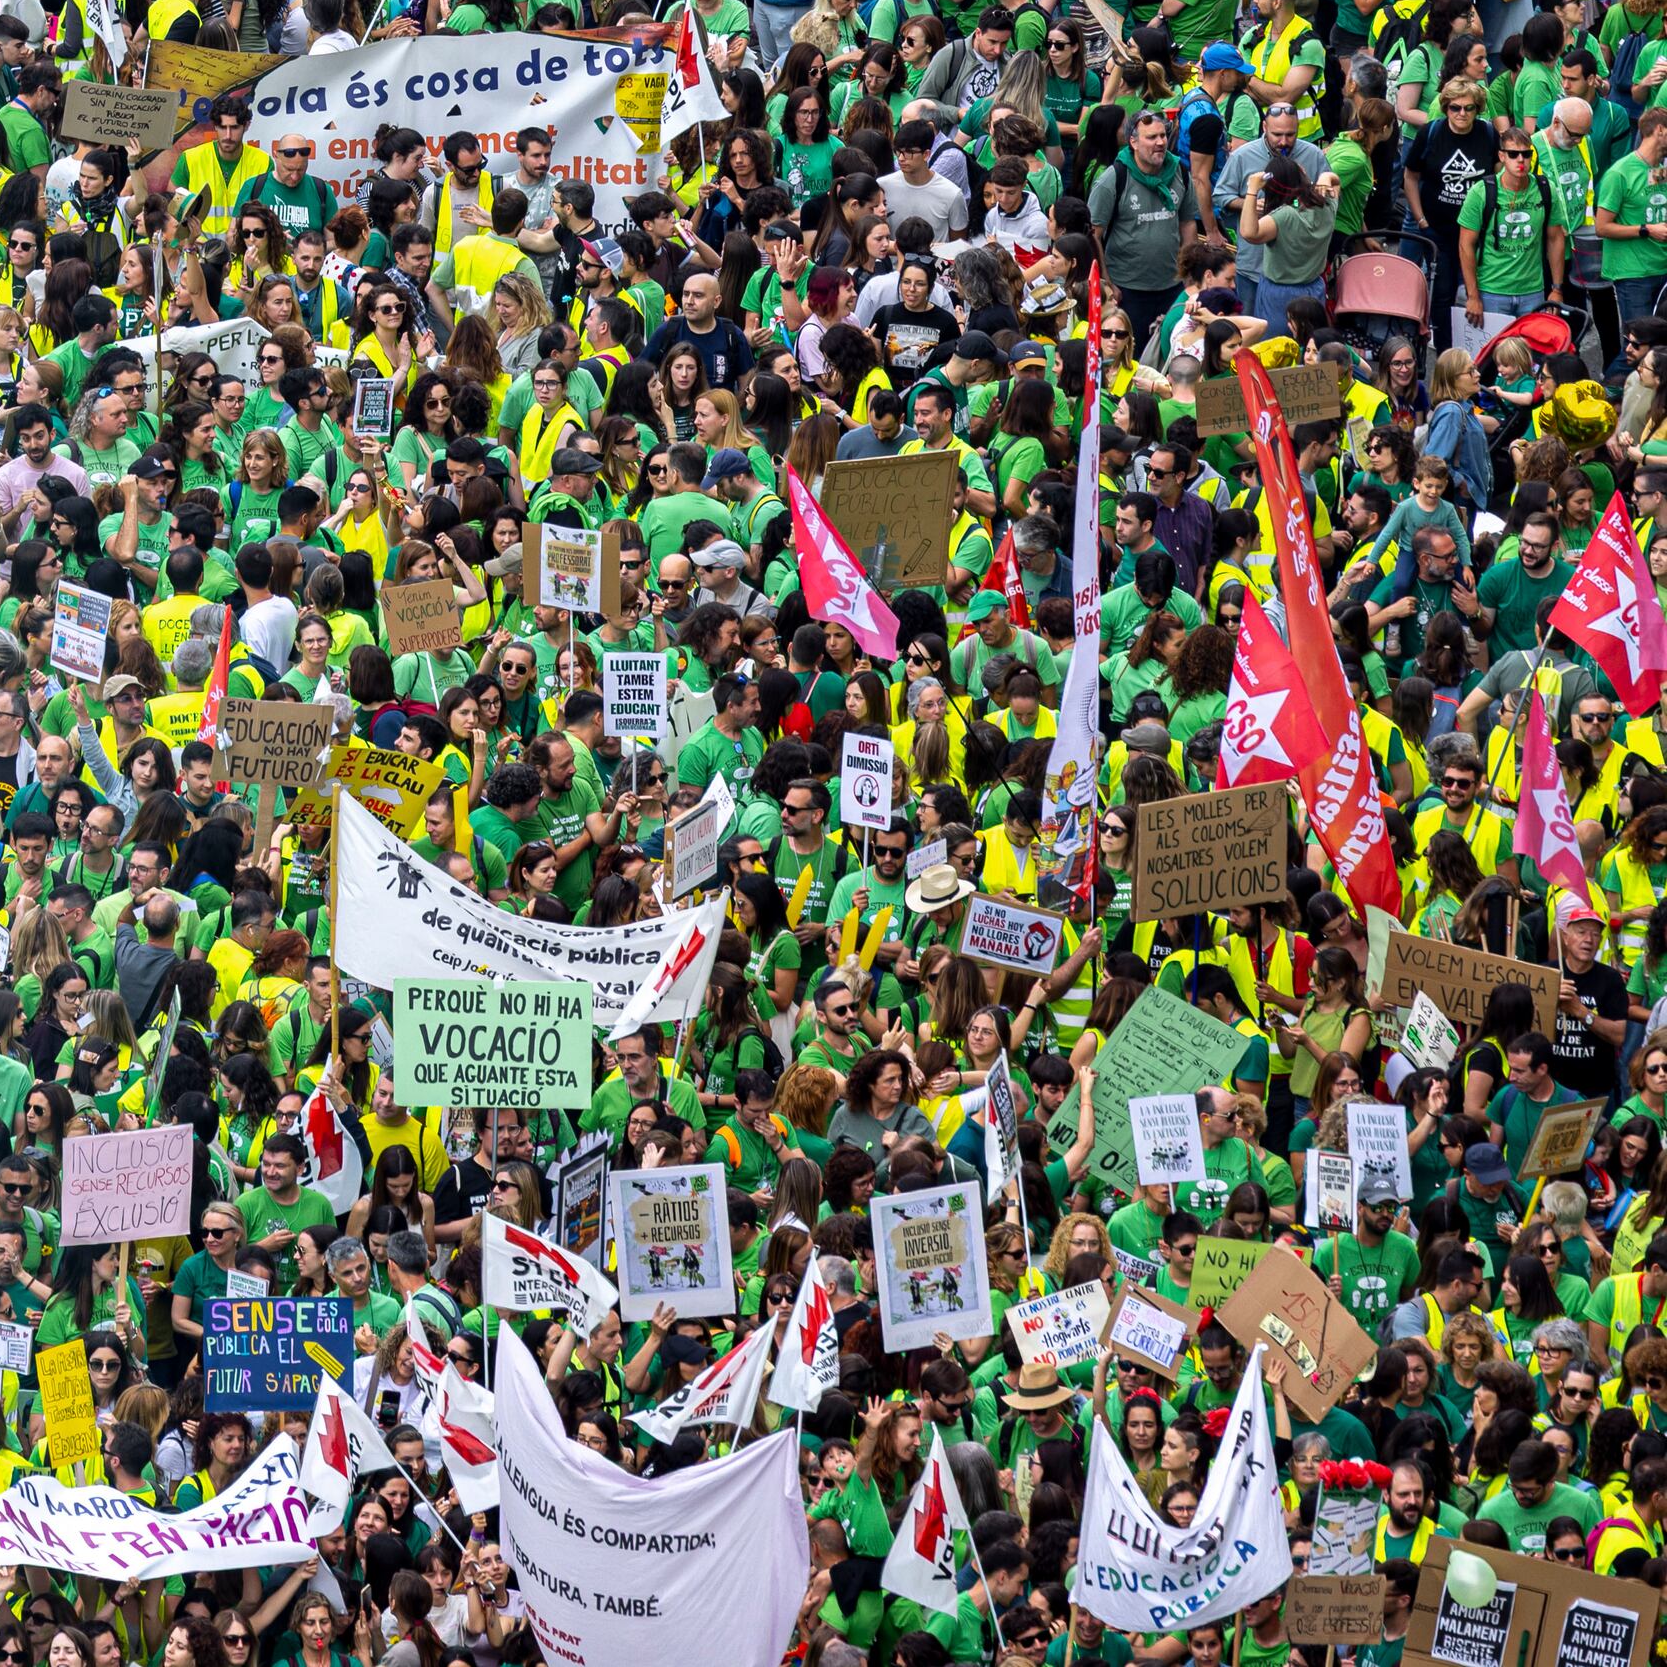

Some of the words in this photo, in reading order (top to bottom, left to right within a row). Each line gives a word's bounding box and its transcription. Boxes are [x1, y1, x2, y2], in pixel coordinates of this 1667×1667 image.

[346, 70, 388, 109] és
[405, 67, 500, 101] cosa
[517, 49, 568, 87] de
[583, 36, 664, 78] tots
[610, 660, 661, 673] LLUITANT
[617, 672, 655, 686] TAMBÉ
[610, 703, 661, 716] EDUCANT
[618, 688, 654, 701] ESTEM
[858, 740, 880, 756] ORTÍ
[847, 755, 888, 775] DIMISSIÓ
[1147, 810, 1174, 832] LES
[1184, 802, 1232, 825] MOLLES
[1245, 794, 1267, 810] PER
[1155, 832, 1179, 850] ALS
[1192, 821, 1245, 843] COLOMS
[1146, 848, 1213, 874] NOSALTRES
[1225, 838, 1267, 860] VOLEM
[1150, 861, 1280, 912] SOLUCIONS
[409, 985, 487, 1015] PERQUÈ
[500, 992, 525, 1016] NO
[534, 993, 551, 1018] HI
[557, 996, 583, 1020] HA
[419, 1017, 561, 1065] VOCACIÓ
[414, 1064, 448, 1085] QUE
[453, 1065, 528, 1085] AGUANTE
[534, 1070, 577, 1088] ESTA
[451, 1085, 540, 1108] SITUACIÓ
[71, 1133, 187, 1173] INCLUSIÓ
[70, 1180, 113, 1197] SENSE
[115, 1163, 190, 1195] RECURSOS
[74, 1189, 181, 1239] EXCLUSIÓ
[211, 1301, 312, 1333] SENSE
[206, 1334, 270, 1356] PÚBLICA
[277, 1338, 301, 1364] EL
[207, 1368, 252, 1395] FUTUR
